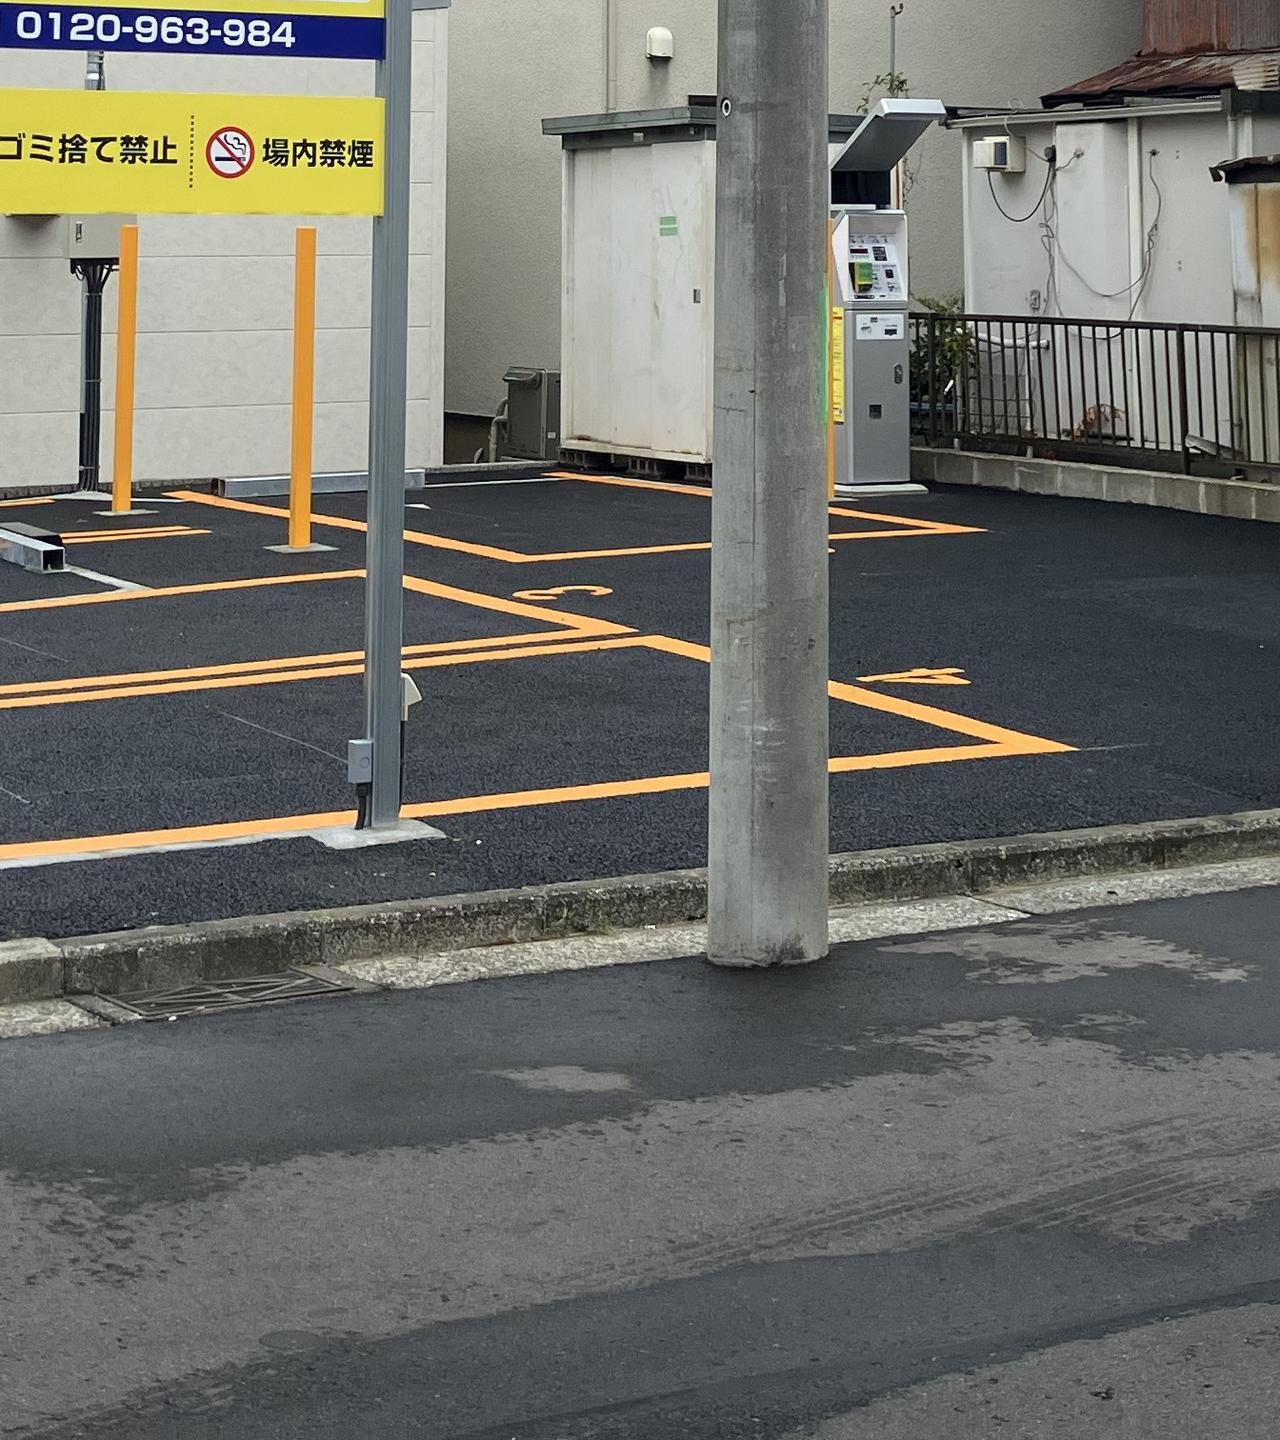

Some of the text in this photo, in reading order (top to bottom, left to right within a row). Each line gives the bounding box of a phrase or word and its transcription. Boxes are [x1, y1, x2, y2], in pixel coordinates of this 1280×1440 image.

[16, 10, 296, 48] 0120-963-984
[263, 138, 374, 168] 場内禁煙
